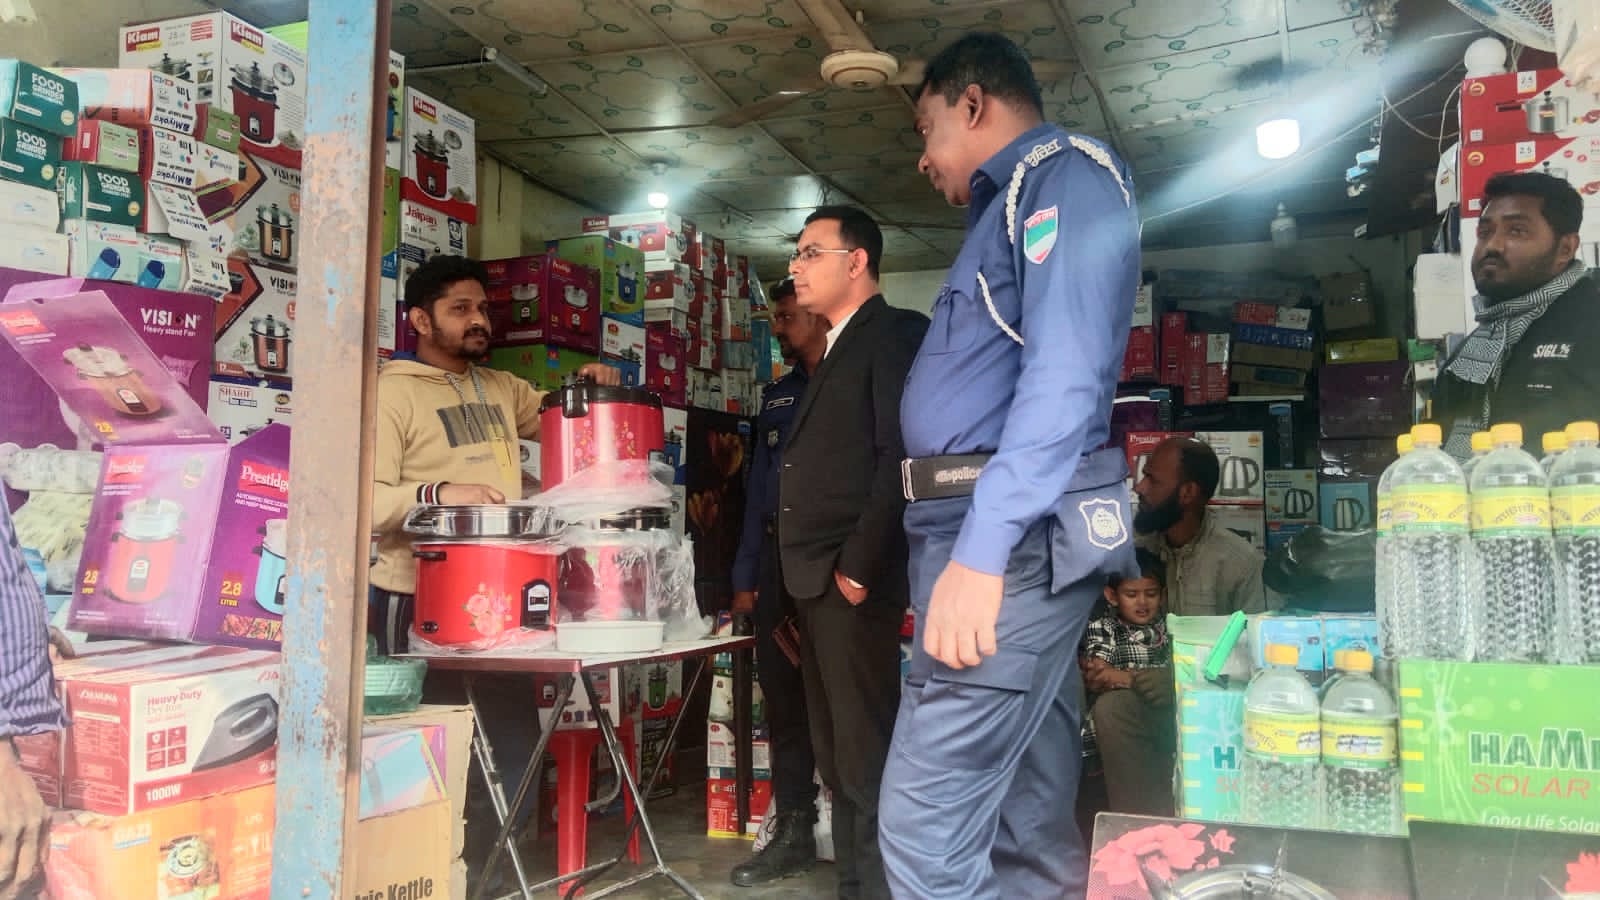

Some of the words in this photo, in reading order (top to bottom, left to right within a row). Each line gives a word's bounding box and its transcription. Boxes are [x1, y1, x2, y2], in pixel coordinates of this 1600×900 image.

[128, 31, 159, 44] Kiam
[232, 22, 262, 46] Kiam
[32, 73, 64, 93] FOOD
[32, 84, 64, 101] GRINDER
[17, 129, 47, 148] FOOD
[97, 172, 129, 187] FOOD
[144, 325, 164, 335] Heavy
[240, 465, 288, 492] Prestidg
[148, 694, 178, 706] Heavy
[180, 689, 202, 701] Duty
[1213, 746, 1241, 770] H
[1469, 728, 1600, 771] HAM
[146, 784, 181, 801] 1000W
[1472, 772, 1592, 800] SOLAR
[387, 876, 433, 900] Kettle
